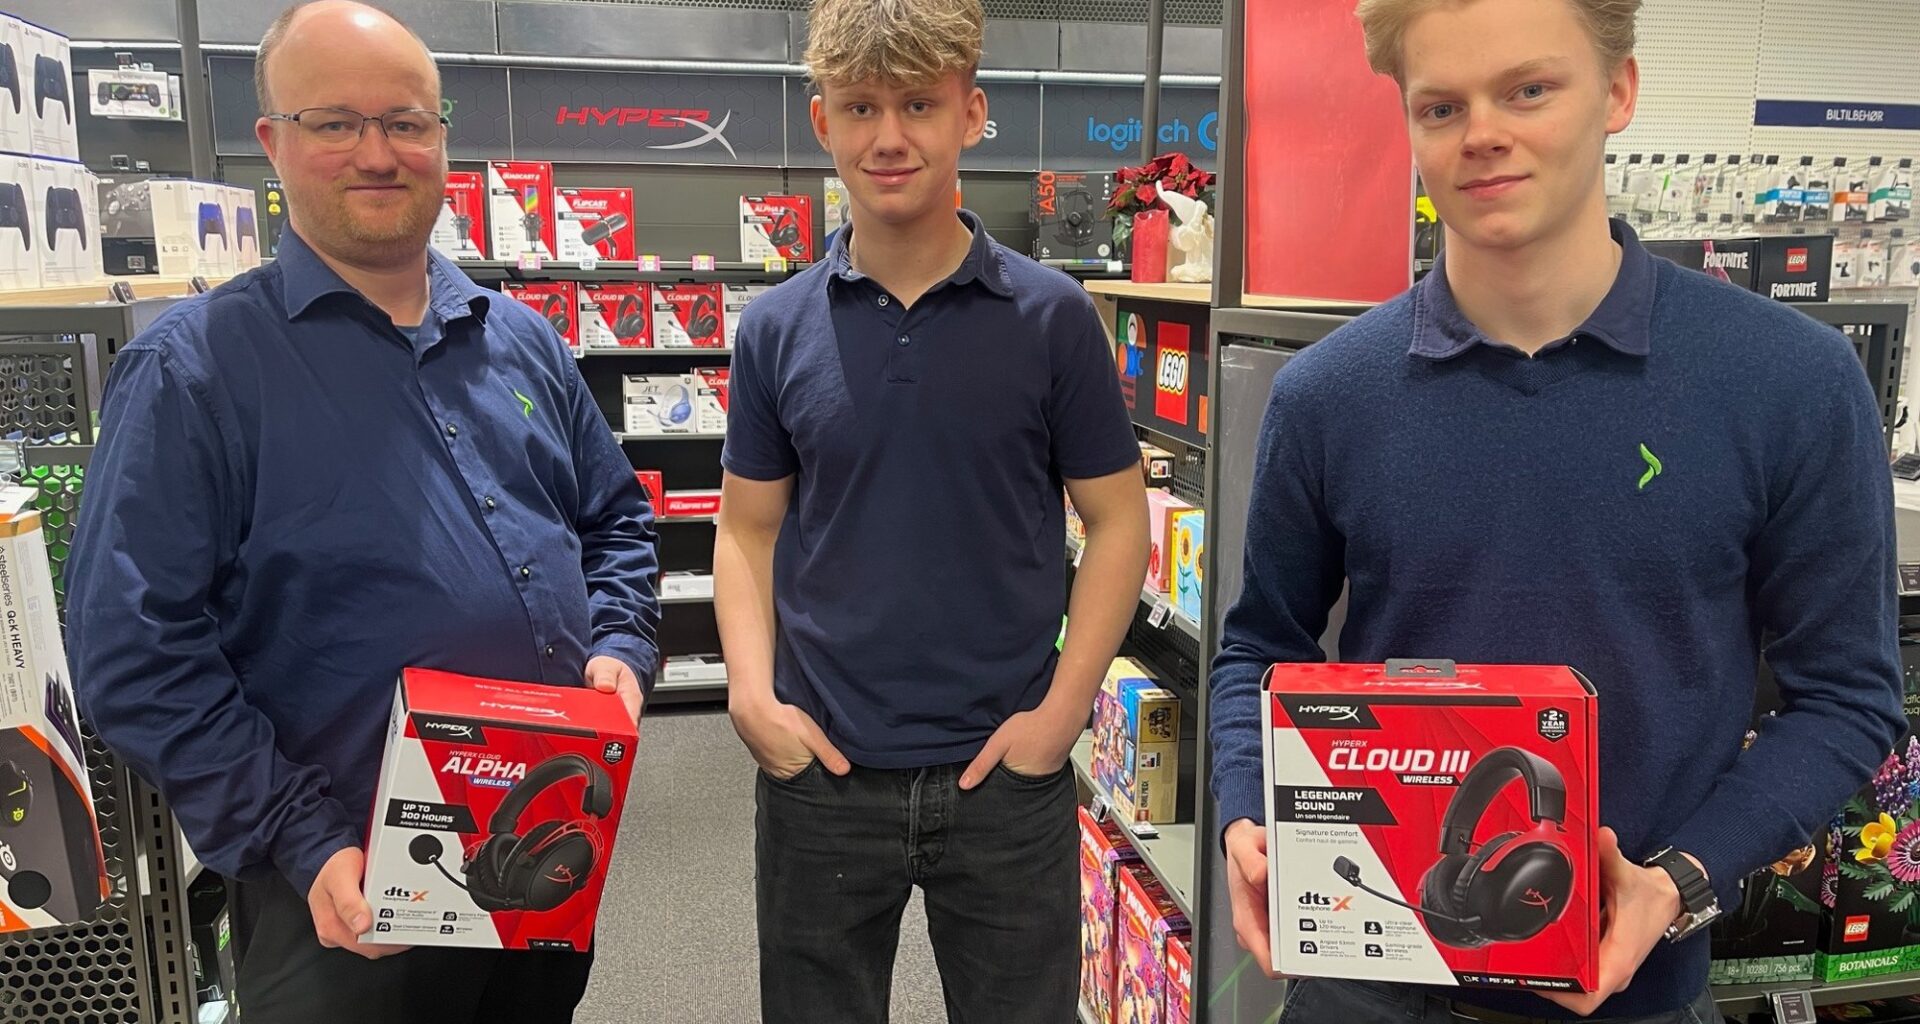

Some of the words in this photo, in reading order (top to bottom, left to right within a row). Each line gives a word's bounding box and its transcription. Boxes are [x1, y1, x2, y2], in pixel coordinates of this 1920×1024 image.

[1826, 108, 1884, 122] BILTILBEHØR
[1088, 117, 1190, 151] logitch
[1040, 171, 1056, 213] A50
[1703, 251, 1749, 269] FORTNITE
[1770, 282, 1818, 299] FORTNITE
[1159, 352, 1187, 392] LEGO
[11, 633, 26, 669] HEAVY
[1299, 705, 1361, 724] HYPERX
[1548, 710, 1558, 720] 2
[425, 721, 473, 739] HYPERX
[1332, 740, 1368, 748] HYPERX
[441, 756, 527, 779] ALPHA
[1328, 748, 1435, 772] CLOUD
[1439, 750, 1471, 773] III
[473, 776, 512, 787] WIRELESS
[1402, 775, 1454, 785] WIRELESS
[1294, 790, 1364, 801] LEGENDARY
[402, 803, 416, 811] UP
[418, 804, 430, 812] TO
[1294, 801, 1335, 811] SOUND
[400, 811, 420, 819] 300
[384, 886, 411, 897] dts
[1298, 891, 1331, 905] dts
[1746, 964, 1769, 975] 10280
[1774, 963, 1788, 973] 756
[1839, 955, 1899, 972] BOTANICALS
